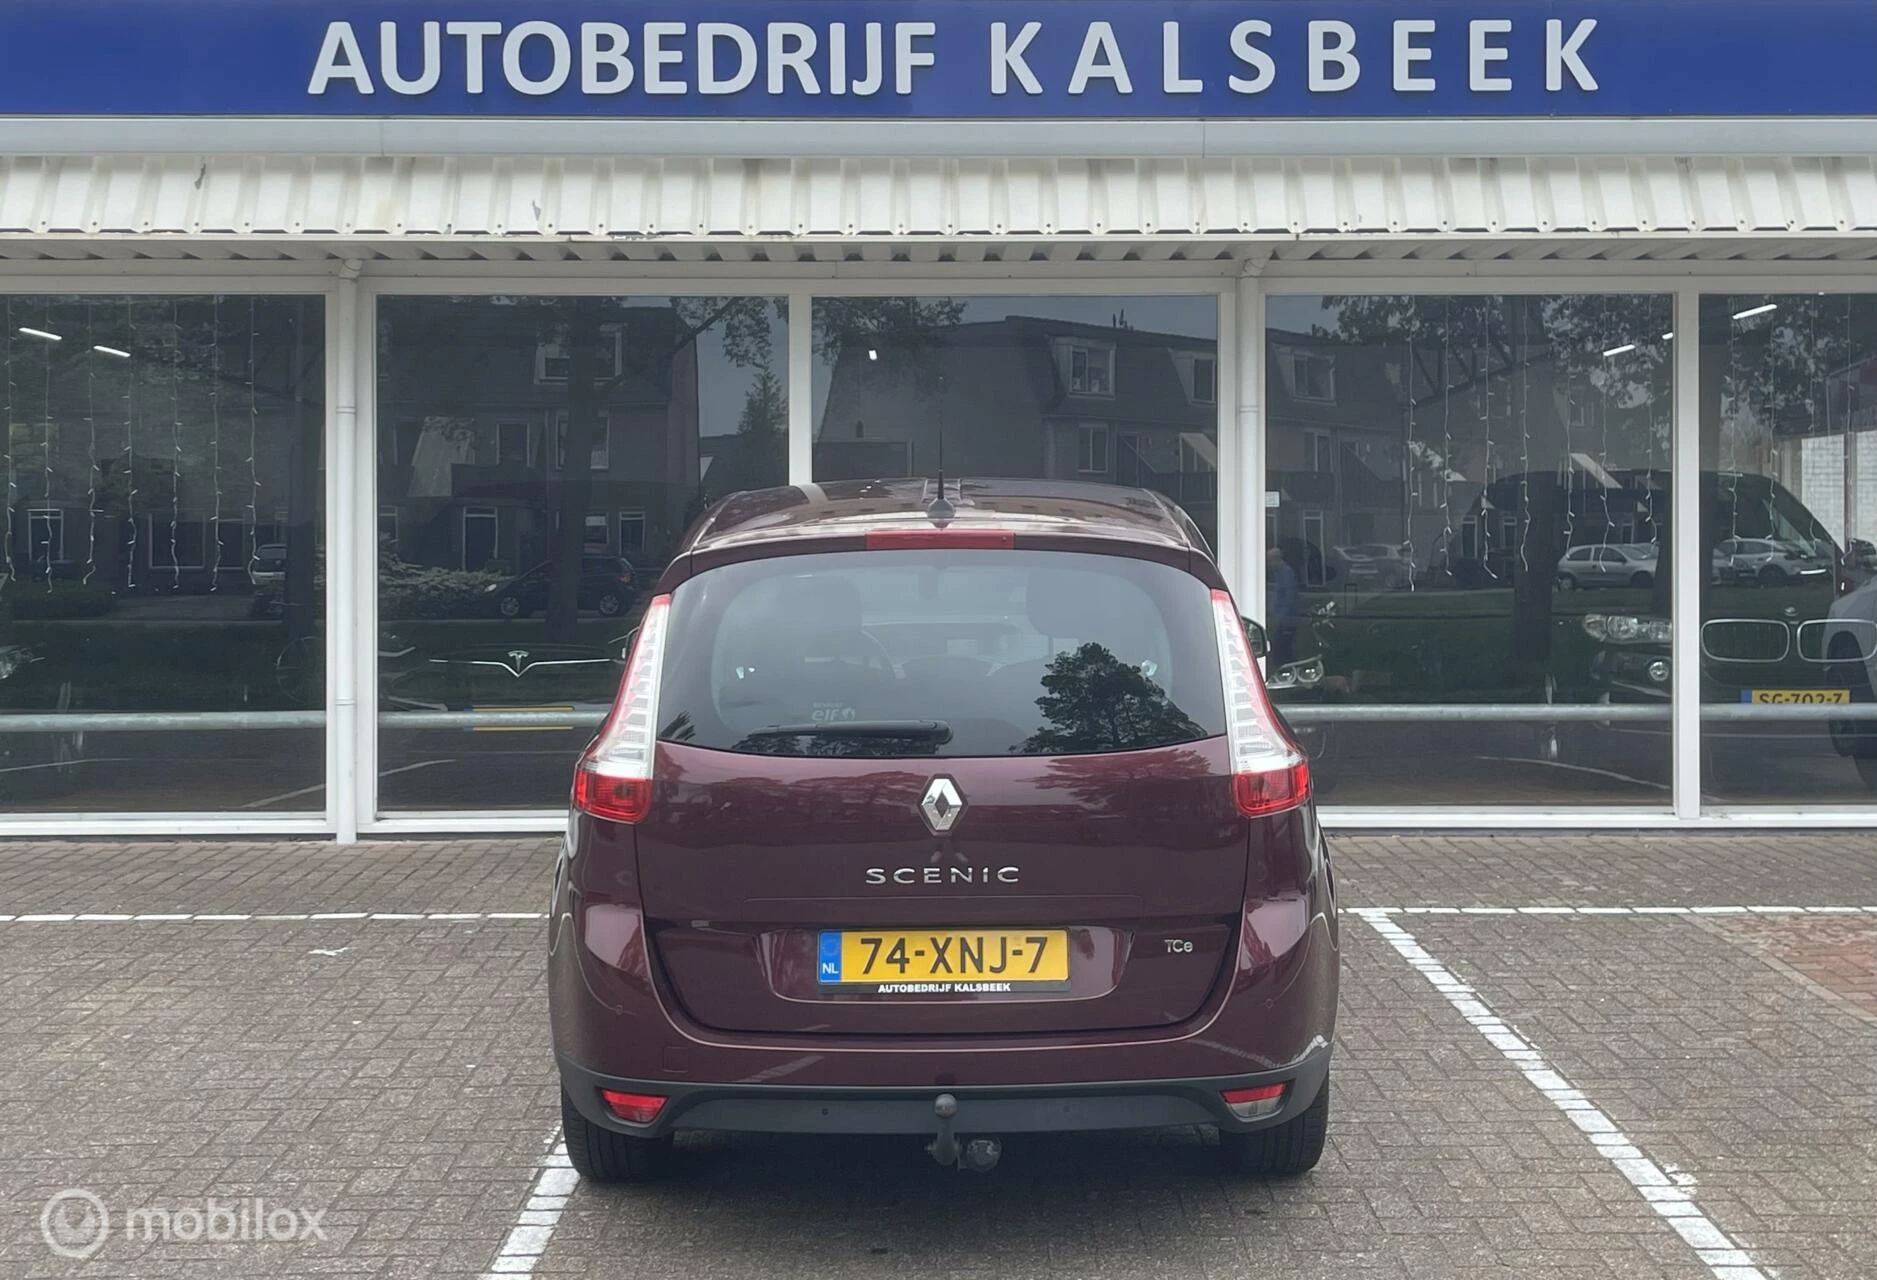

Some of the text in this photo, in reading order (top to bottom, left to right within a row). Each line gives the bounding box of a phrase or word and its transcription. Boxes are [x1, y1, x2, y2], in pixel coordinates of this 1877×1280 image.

[307, 18, 1600, 96] AUTOBEDRIJF KALSBEEK
[865, 866, 1020, 885] SCENIC
[1164, 939, 1194, 953] TCe
[860, 936, 1049, 975] 74-XNJ-7
[822, 962, 839, 974] NL
[877, 982, 1011, 993] AUTOBEDRIJF KALSBEEK
